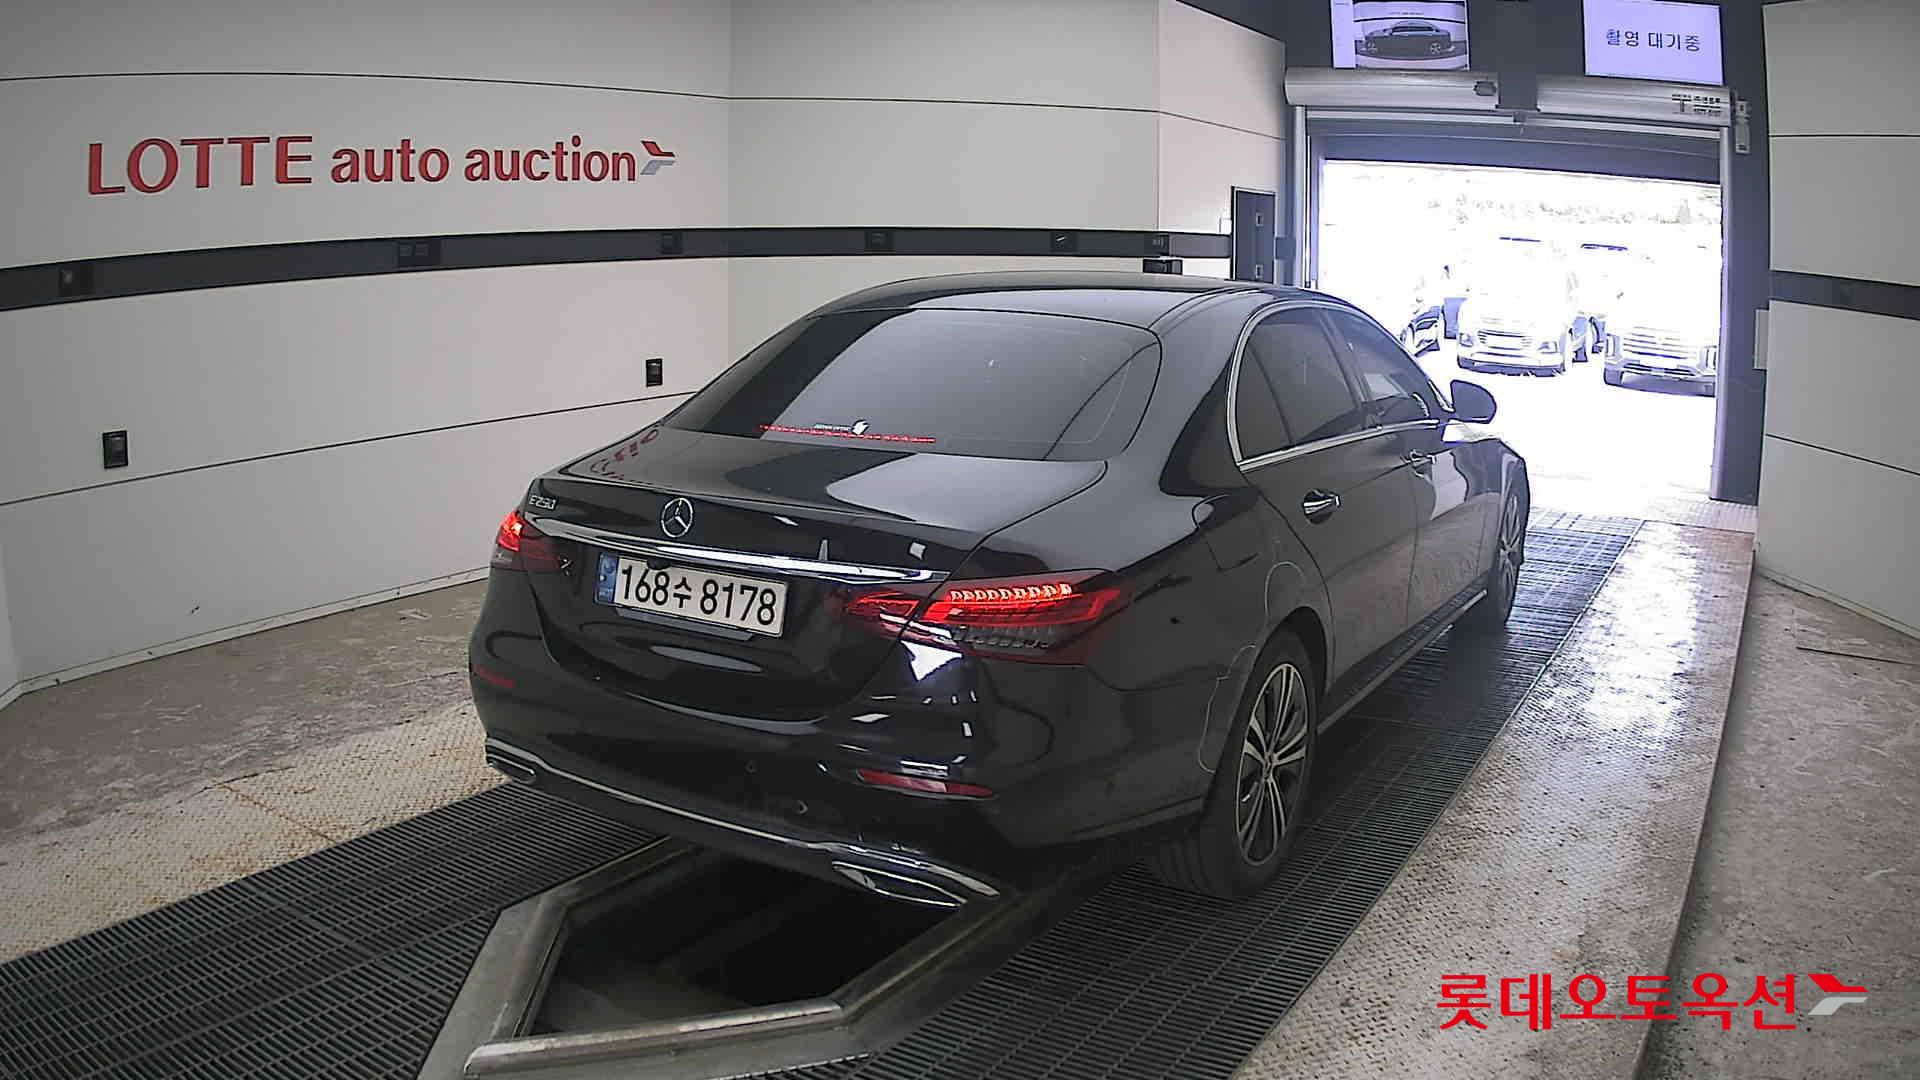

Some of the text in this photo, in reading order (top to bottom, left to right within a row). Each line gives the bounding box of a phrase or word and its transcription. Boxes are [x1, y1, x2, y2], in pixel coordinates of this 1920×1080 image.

[1648, 32, 1701, 52] 대기중
[88, 135, 637, 195] LOTTE auto auction
[621, 564, 777, 626] 168수 8178
